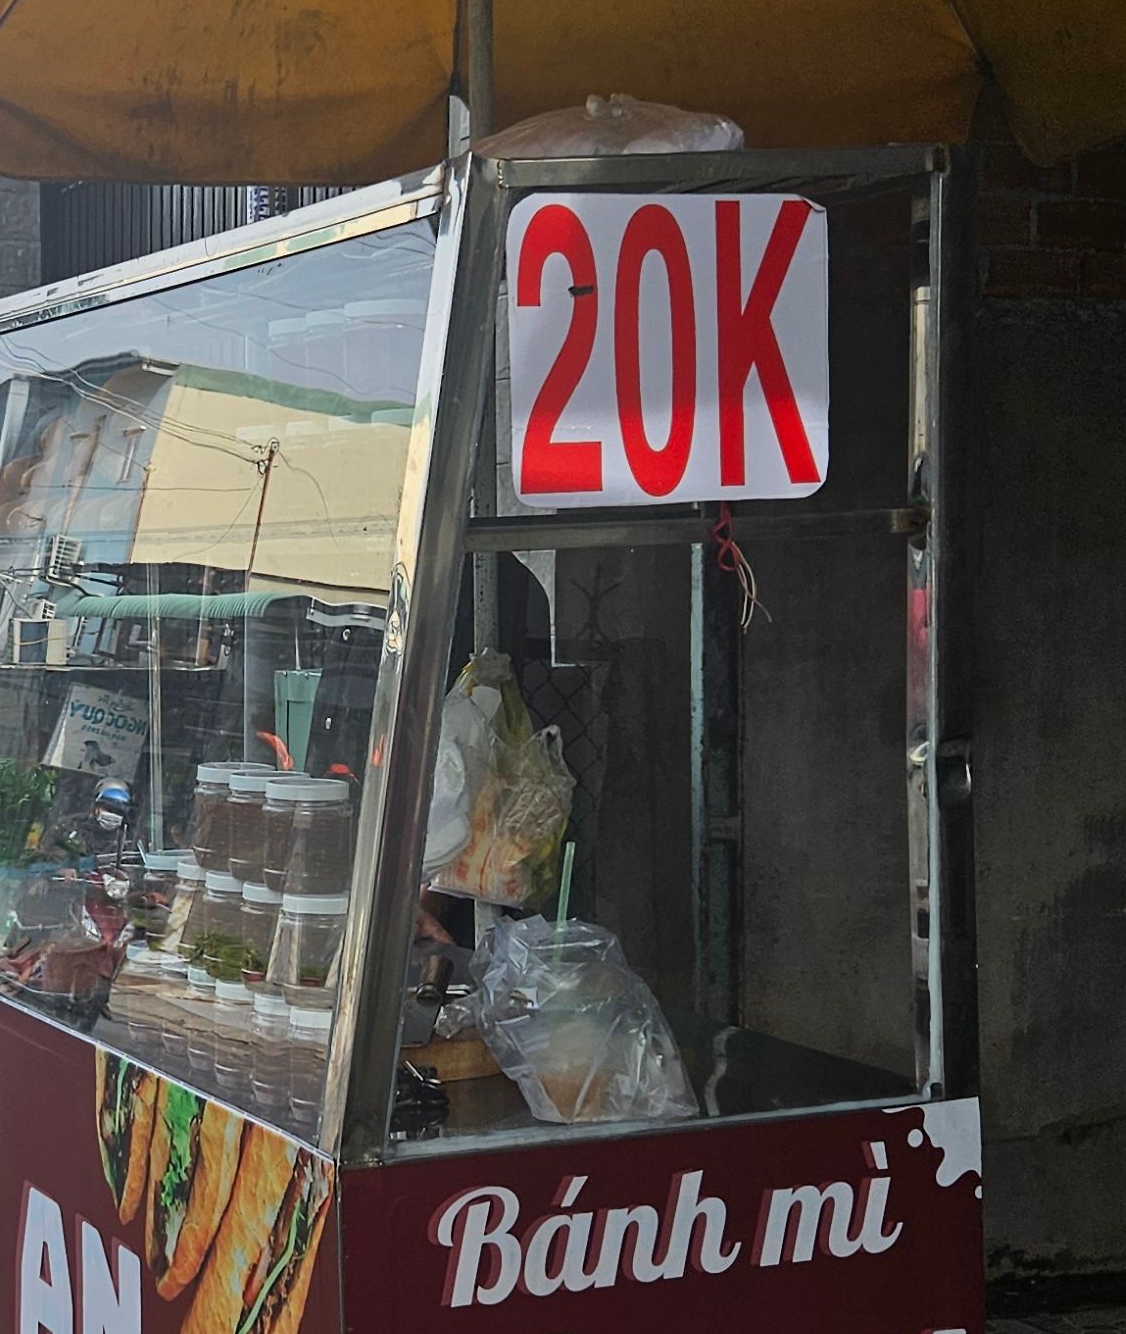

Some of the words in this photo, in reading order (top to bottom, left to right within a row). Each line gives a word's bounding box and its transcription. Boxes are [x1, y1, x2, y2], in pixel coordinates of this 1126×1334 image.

[517, 199, 821, 497] 20K
[435, 1170, 742, 1308] Bánh
[757, 1141, 903, 1267] mì
